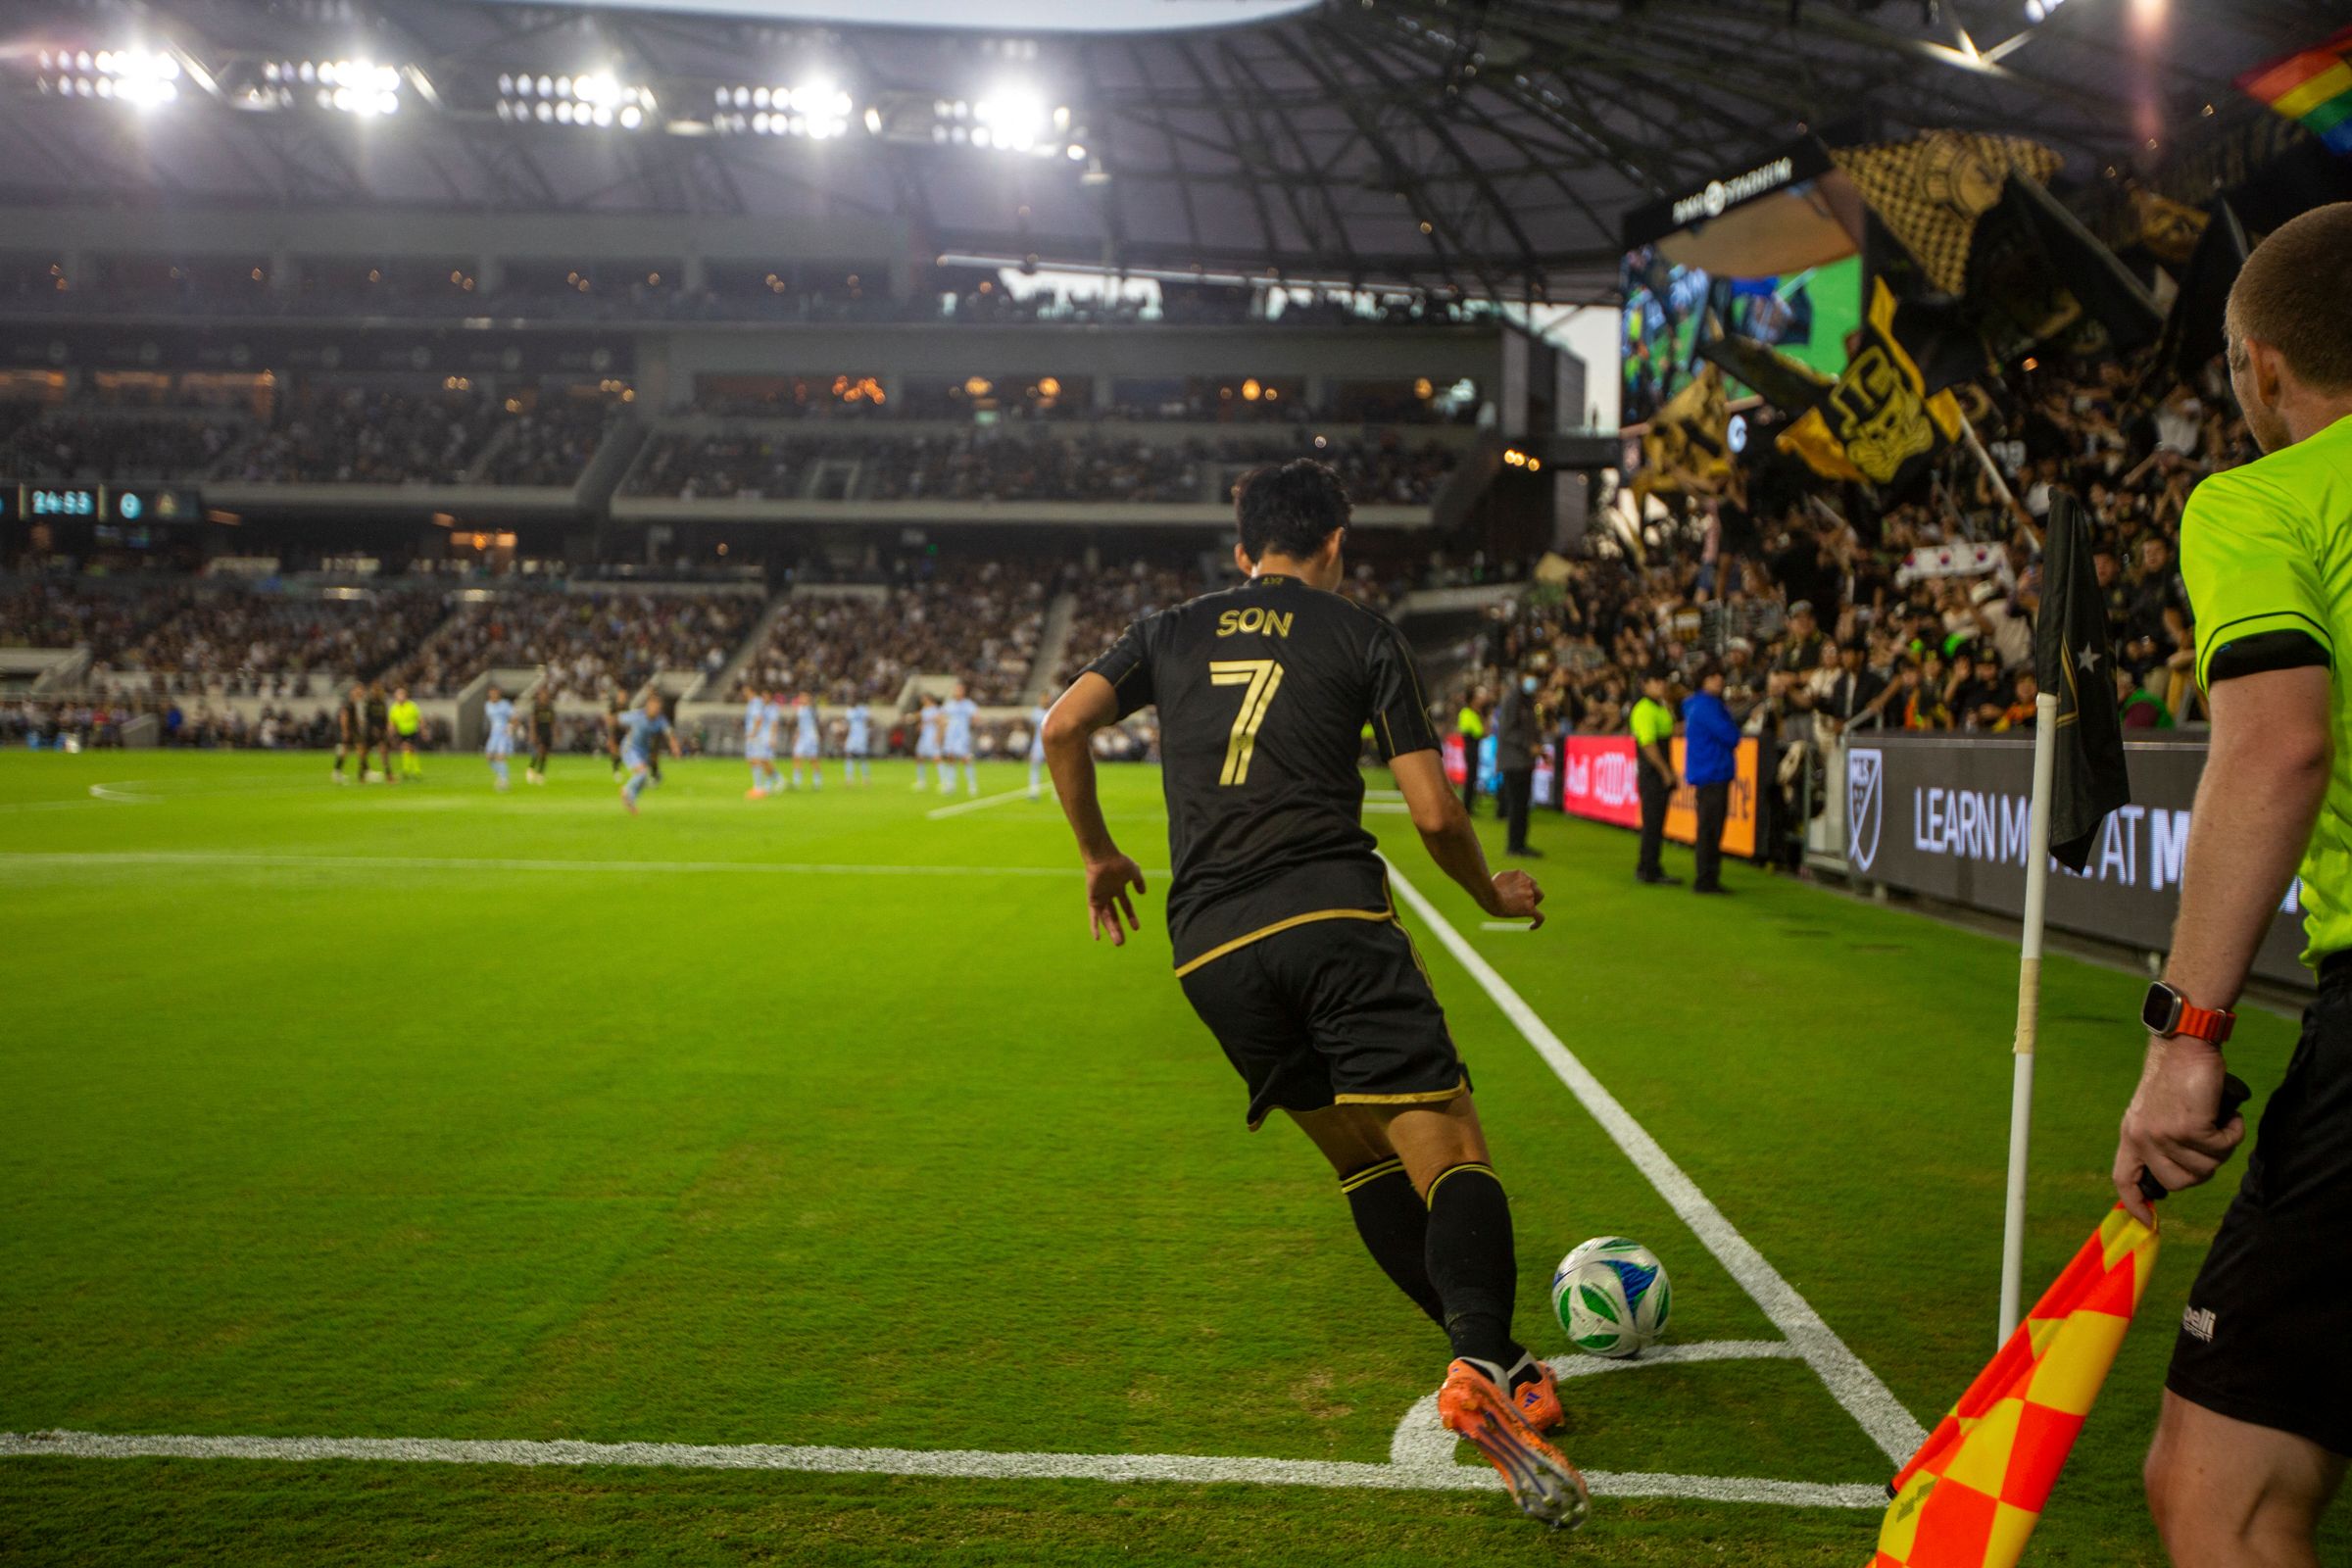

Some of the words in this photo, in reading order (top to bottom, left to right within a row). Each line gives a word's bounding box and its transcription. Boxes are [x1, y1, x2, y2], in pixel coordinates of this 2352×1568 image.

[1216, 608, 1294, 638] SON
[1209, 660, 1285, 786] 7
[1914, 785, 1995, 862] LEARN
[2099, 804, 2144, 886] AT
